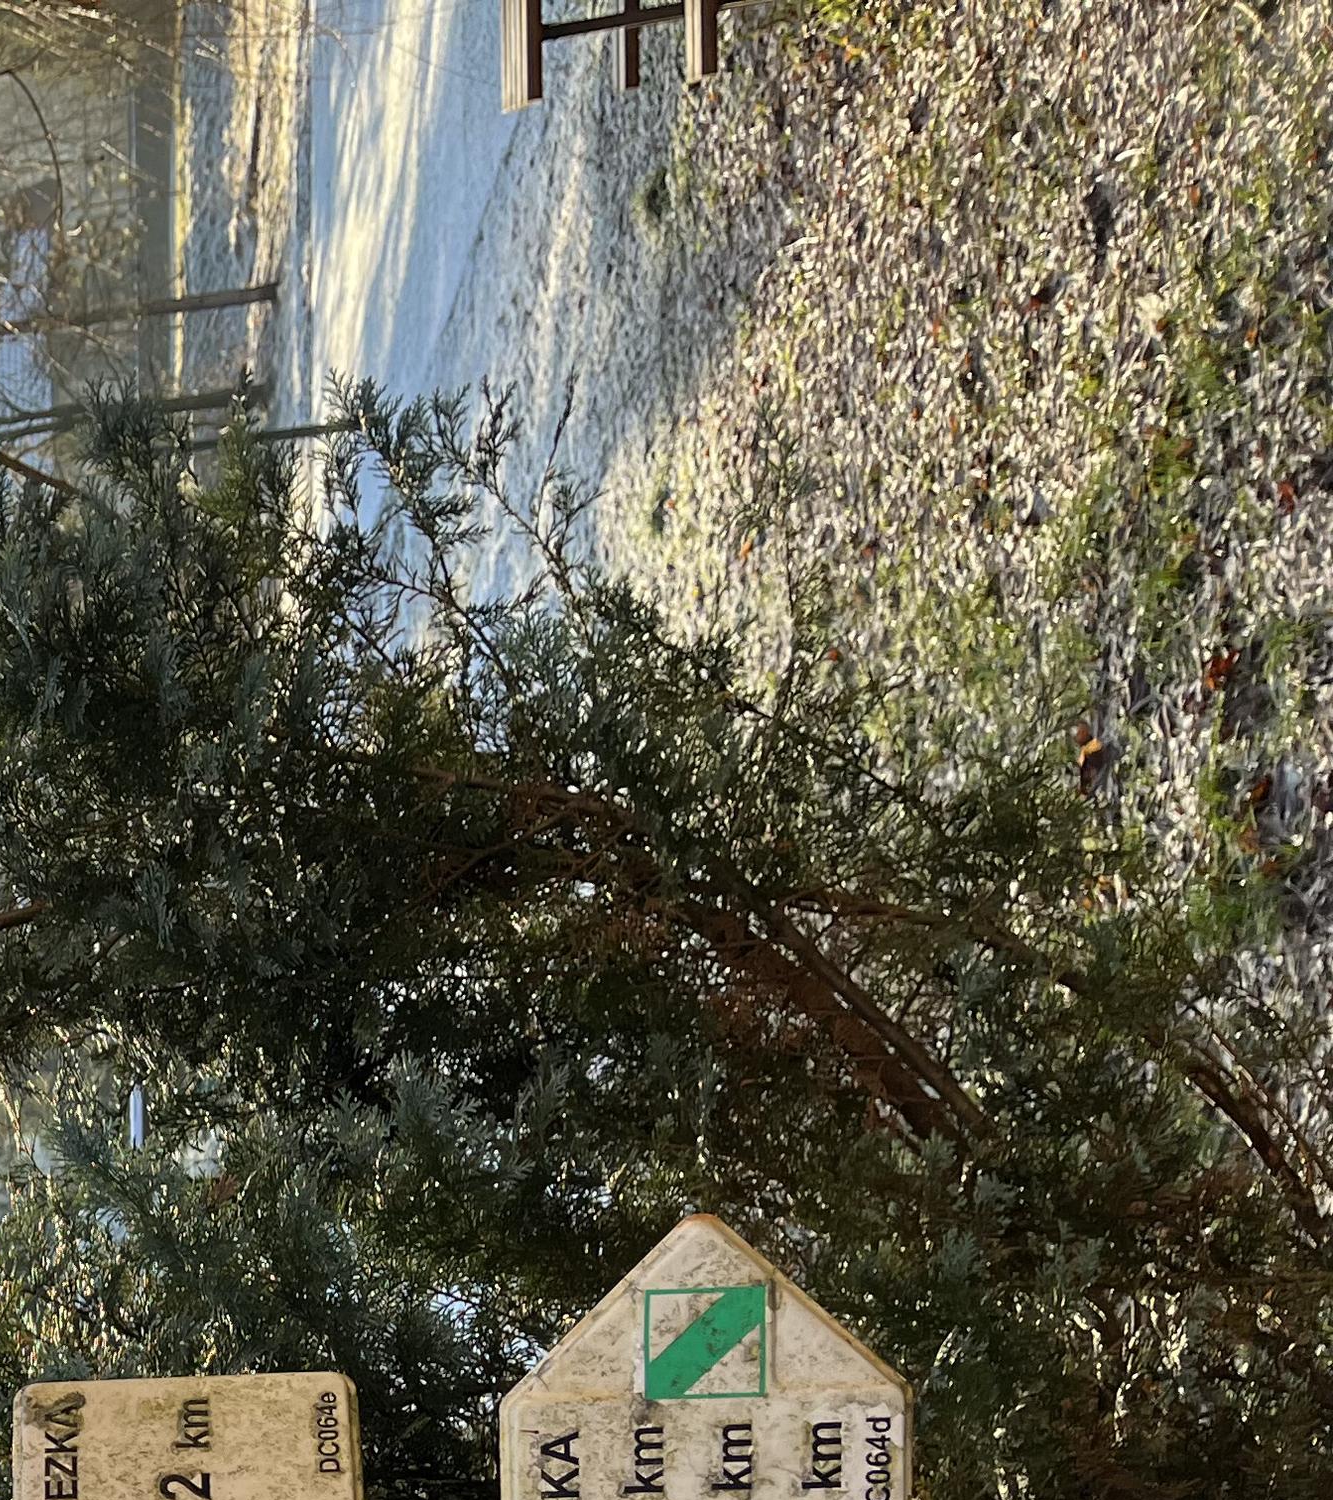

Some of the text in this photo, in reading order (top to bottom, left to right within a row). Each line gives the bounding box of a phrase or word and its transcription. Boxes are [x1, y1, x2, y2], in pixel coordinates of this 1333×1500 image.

[159, 1399, 212, 1500] 2 km
[317, 1392, 341, 1473] DC064e
[624, 1426, 664, 1493] km
[712, 1423, 752, 1491] km
[802, 1421, 842, 1489] km
